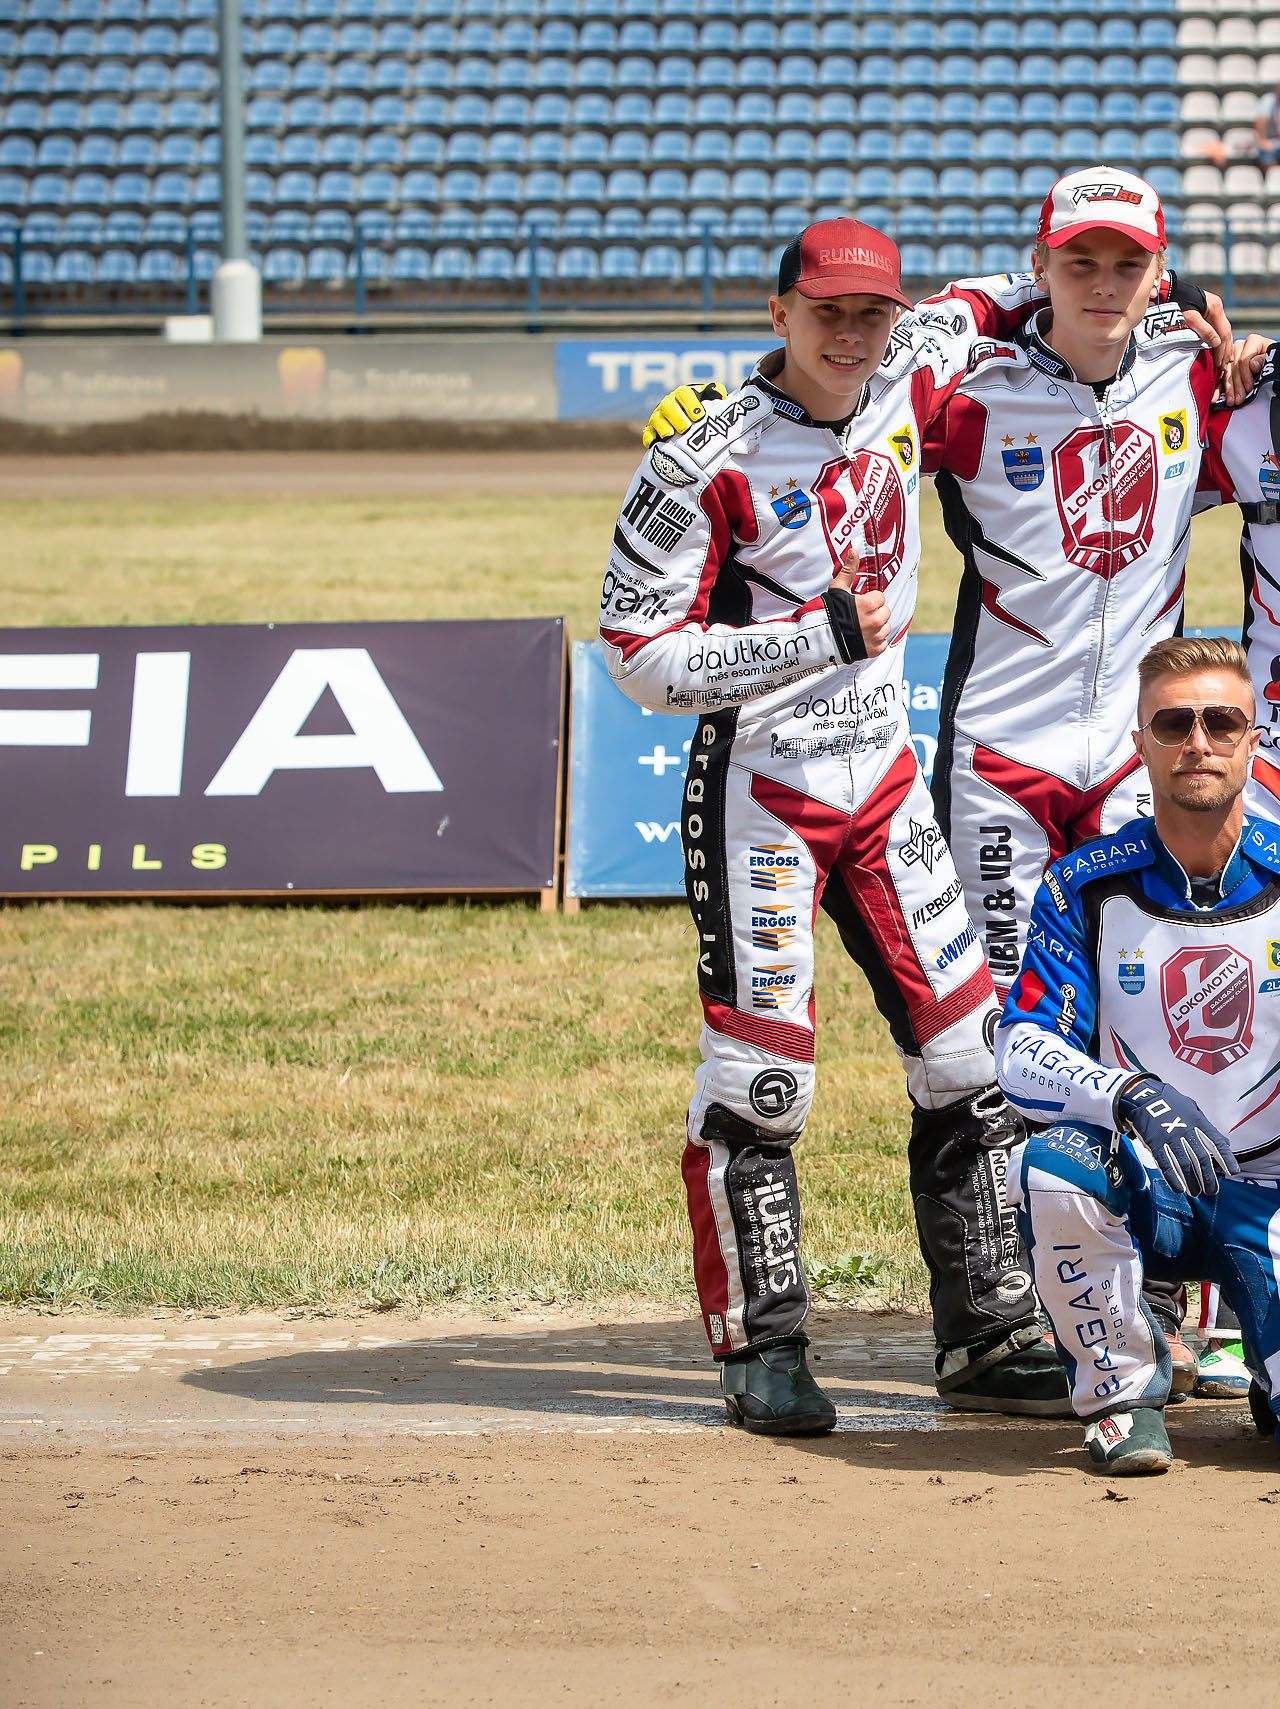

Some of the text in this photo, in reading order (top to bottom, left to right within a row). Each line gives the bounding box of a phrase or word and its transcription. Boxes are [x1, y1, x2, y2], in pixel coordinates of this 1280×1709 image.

[818, 246, 894, 276] RUNNING
[659, 497, 697, 528] ARNIS
[730, 667, 761, 679] esam
[20, 843, 229, 871] PILS
[750, 855, 800, 868] ERGOSS
[1062, 839, 1149, 882] SAGARI
[750, 915, 797, 929] ERGOSS
[751, 974, 797, 988] ERGOSS
[1171, 957, 1240, 1021] LOKOMOTIV
[1209, 974, 1248, 1010] DAUGAVPILS
[1011, 1036, 1124, 1093] SAGARI
[1021, 1067, 1072, 1097] SPORTS
[1132, 1086, 1188, 1133] FOX
[1032, 1126, 1102, 1164] SAGA
[743, 1187, 760, 1223] portāls
[1052, 1243, 1119, 1399] SAGARI
[1100, 1278, 1126, 1350] SPORTS
